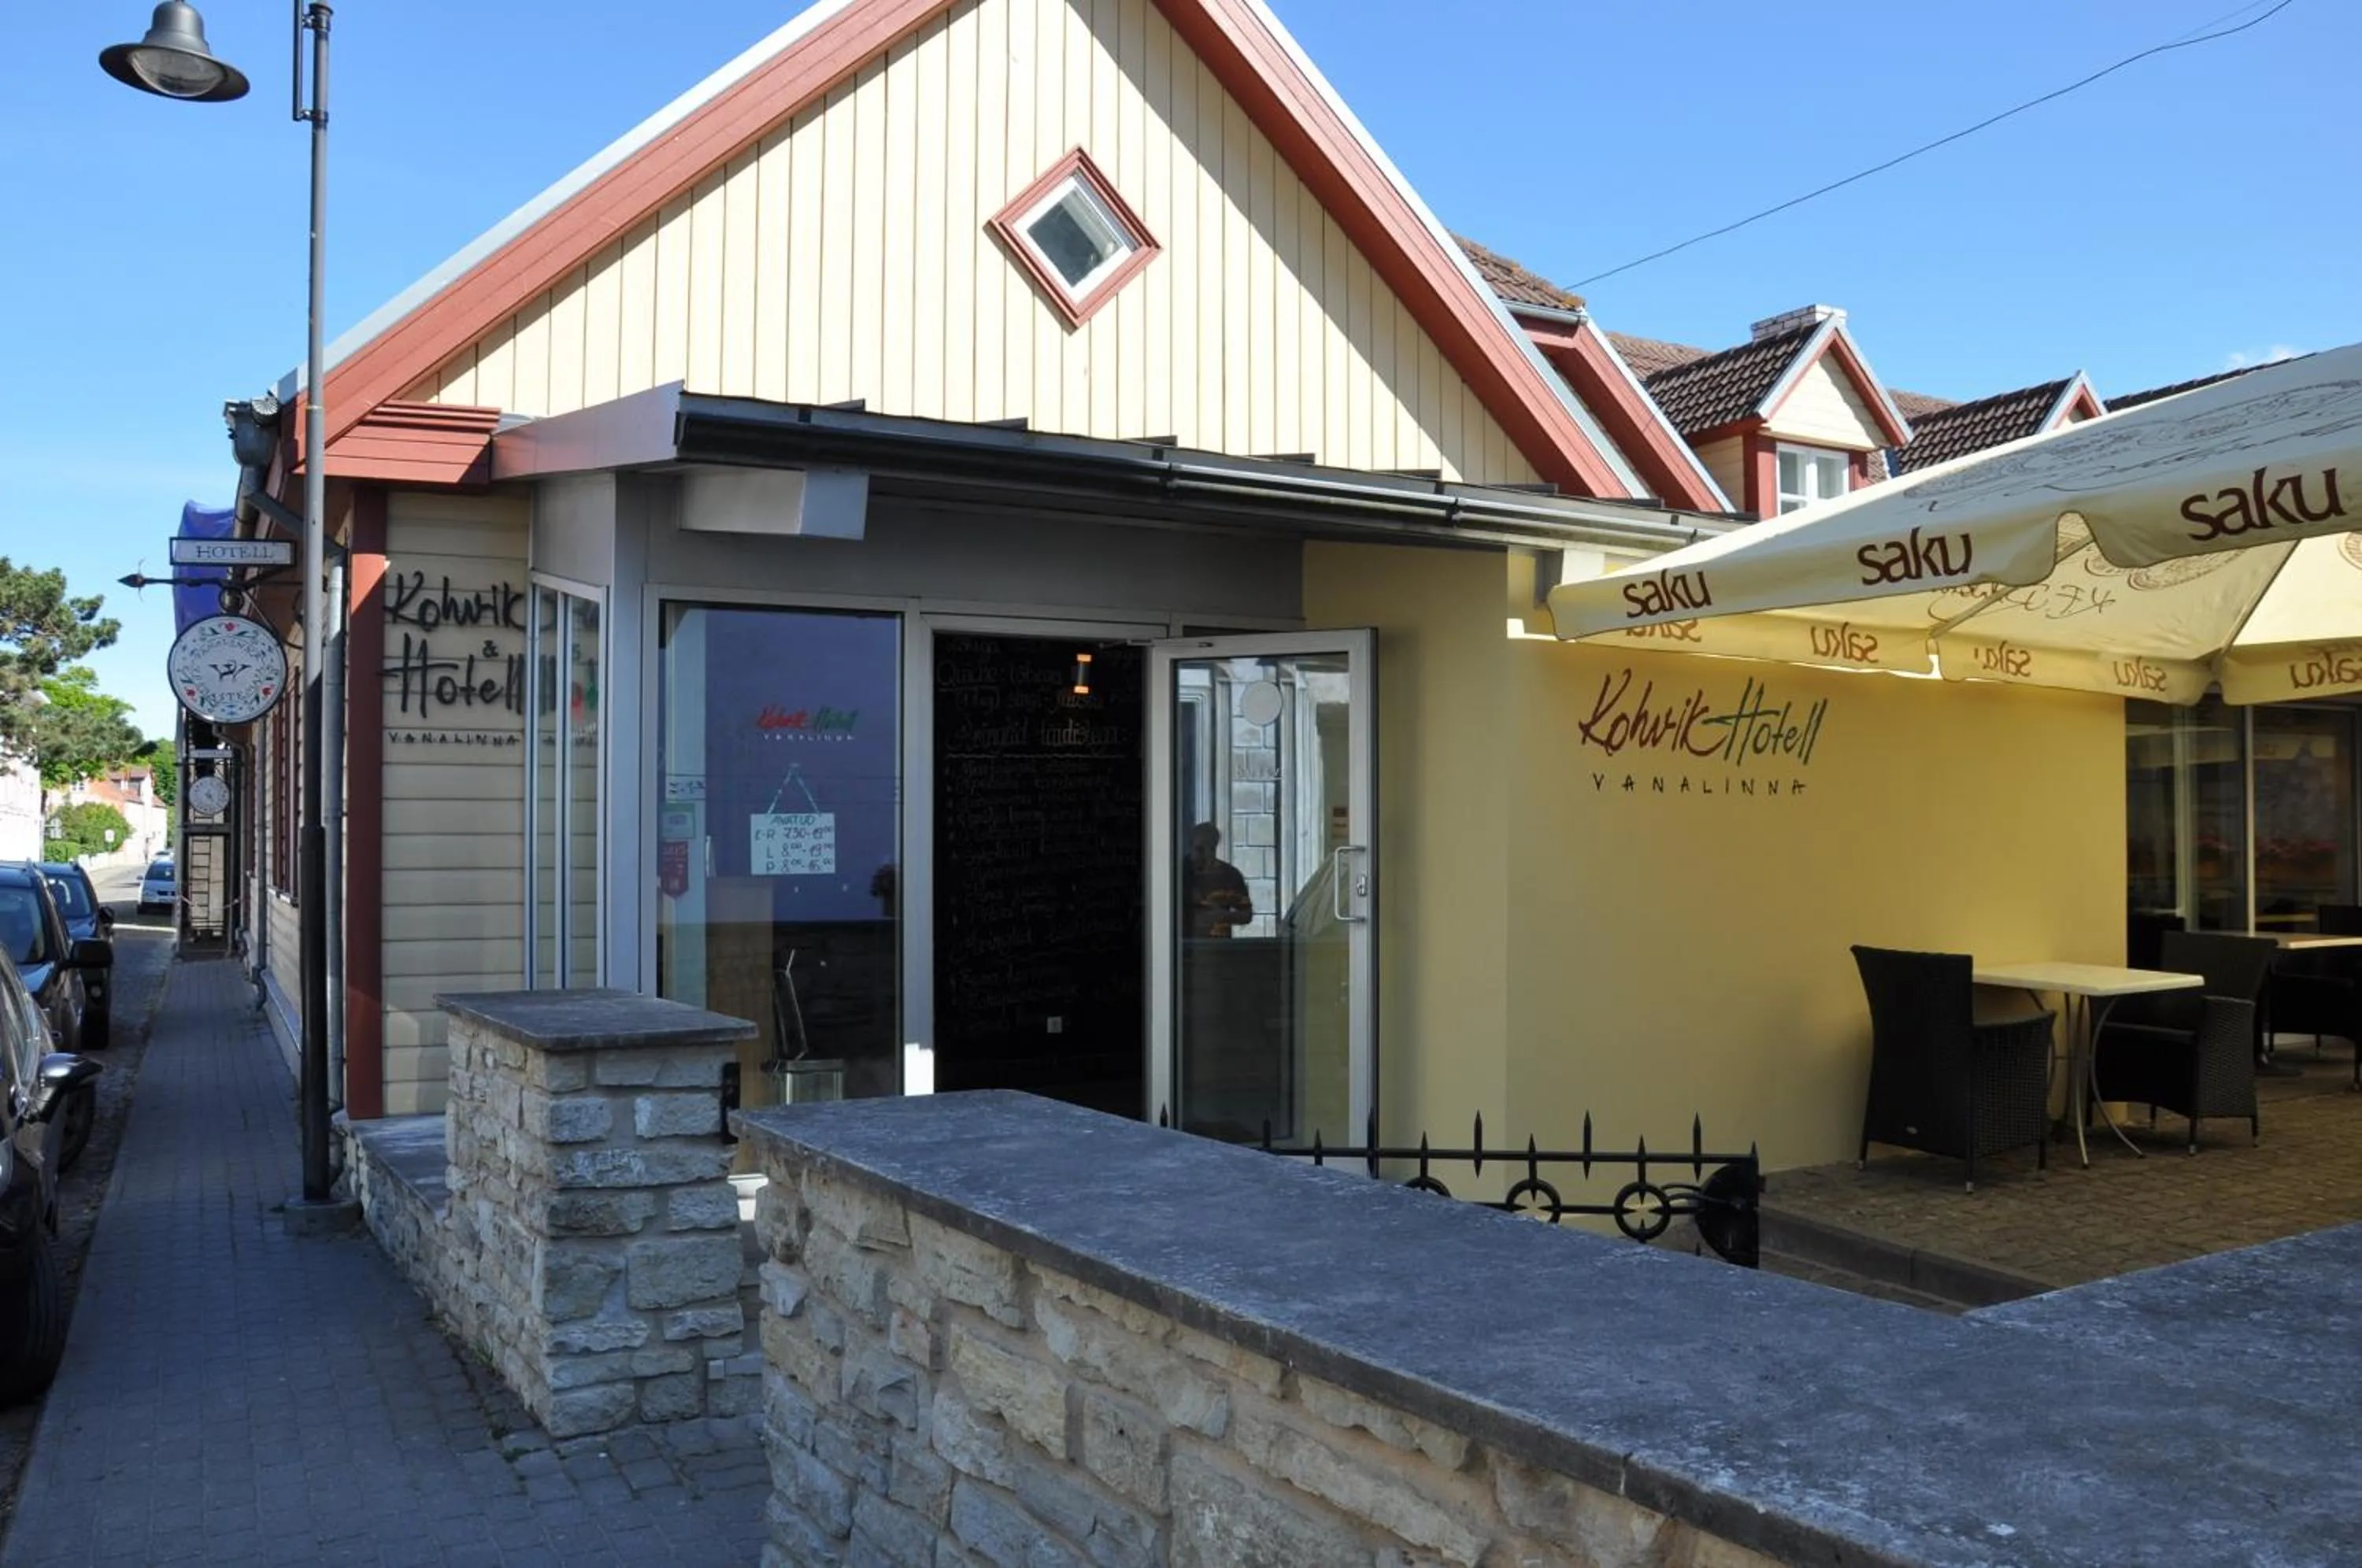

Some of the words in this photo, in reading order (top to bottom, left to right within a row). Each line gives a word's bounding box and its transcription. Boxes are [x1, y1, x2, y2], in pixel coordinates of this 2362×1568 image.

[2180, 465, 2348, 541] saku
[195, 545, 275, 559] HOTELL
[1857, 527, 1973, 586] saku
[1623, 568, 1712, 619] saku
[482, 639, 499, 659] &
[376, 632, 525, 718] Hotell
[389, 732, 520, 746] VANALINNA
[1701, 676, 1828, 767] Hotell
[1592, 772, 1807, 796] VANALINNA
